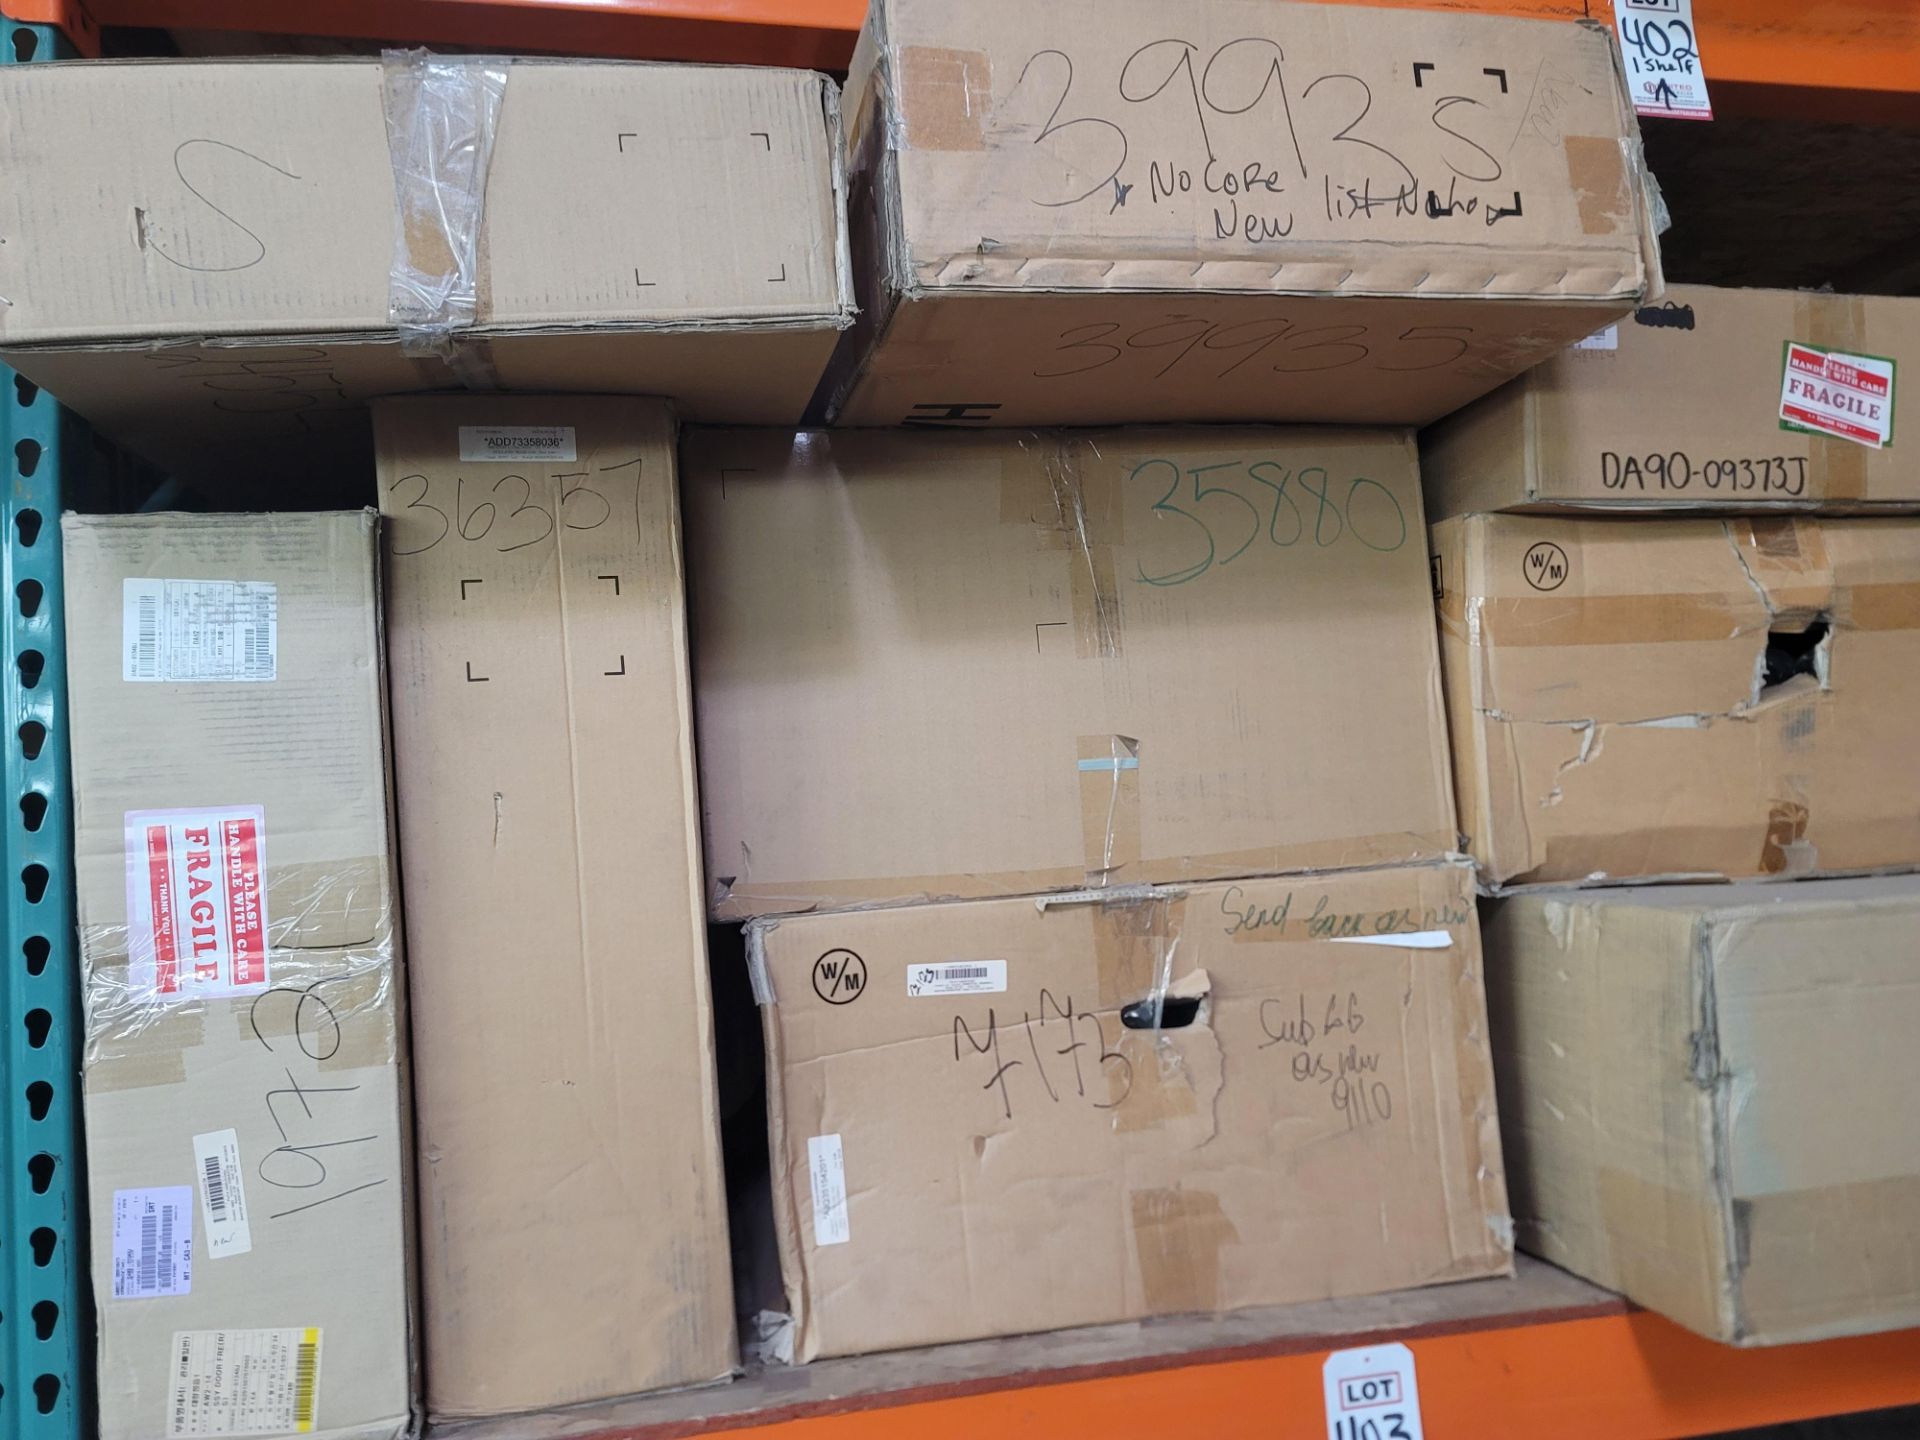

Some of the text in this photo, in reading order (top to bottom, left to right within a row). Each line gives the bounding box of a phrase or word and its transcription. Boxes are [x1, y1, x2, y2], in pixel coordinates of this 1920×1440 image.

[1622, 16, 1699, 60] 402
[1150, 160, 1191, 203] No
[1213, 199, 1294, 243] New
[1788, 377, 1881, 421] FRAGILE
[1833, 371, 1859, 386] WITH
[1859, 378, 1886, 394] CARE
[1601, 451, 1808, 496] DA90-09373J
[389, 457, 643, 556] 36357
[1128, 458, 1406, 587] 35880
[159, 882, 168, 914] THANK
[184, 826, 219, 983] FRAGILE
[228, 824, 249, 981] HANDLE WITH CARE
[243, 872, 258, 930] PLEASE
[1221, 886, 1292, 935] Send
[1346, 1379, 1394, 1403] LOT
